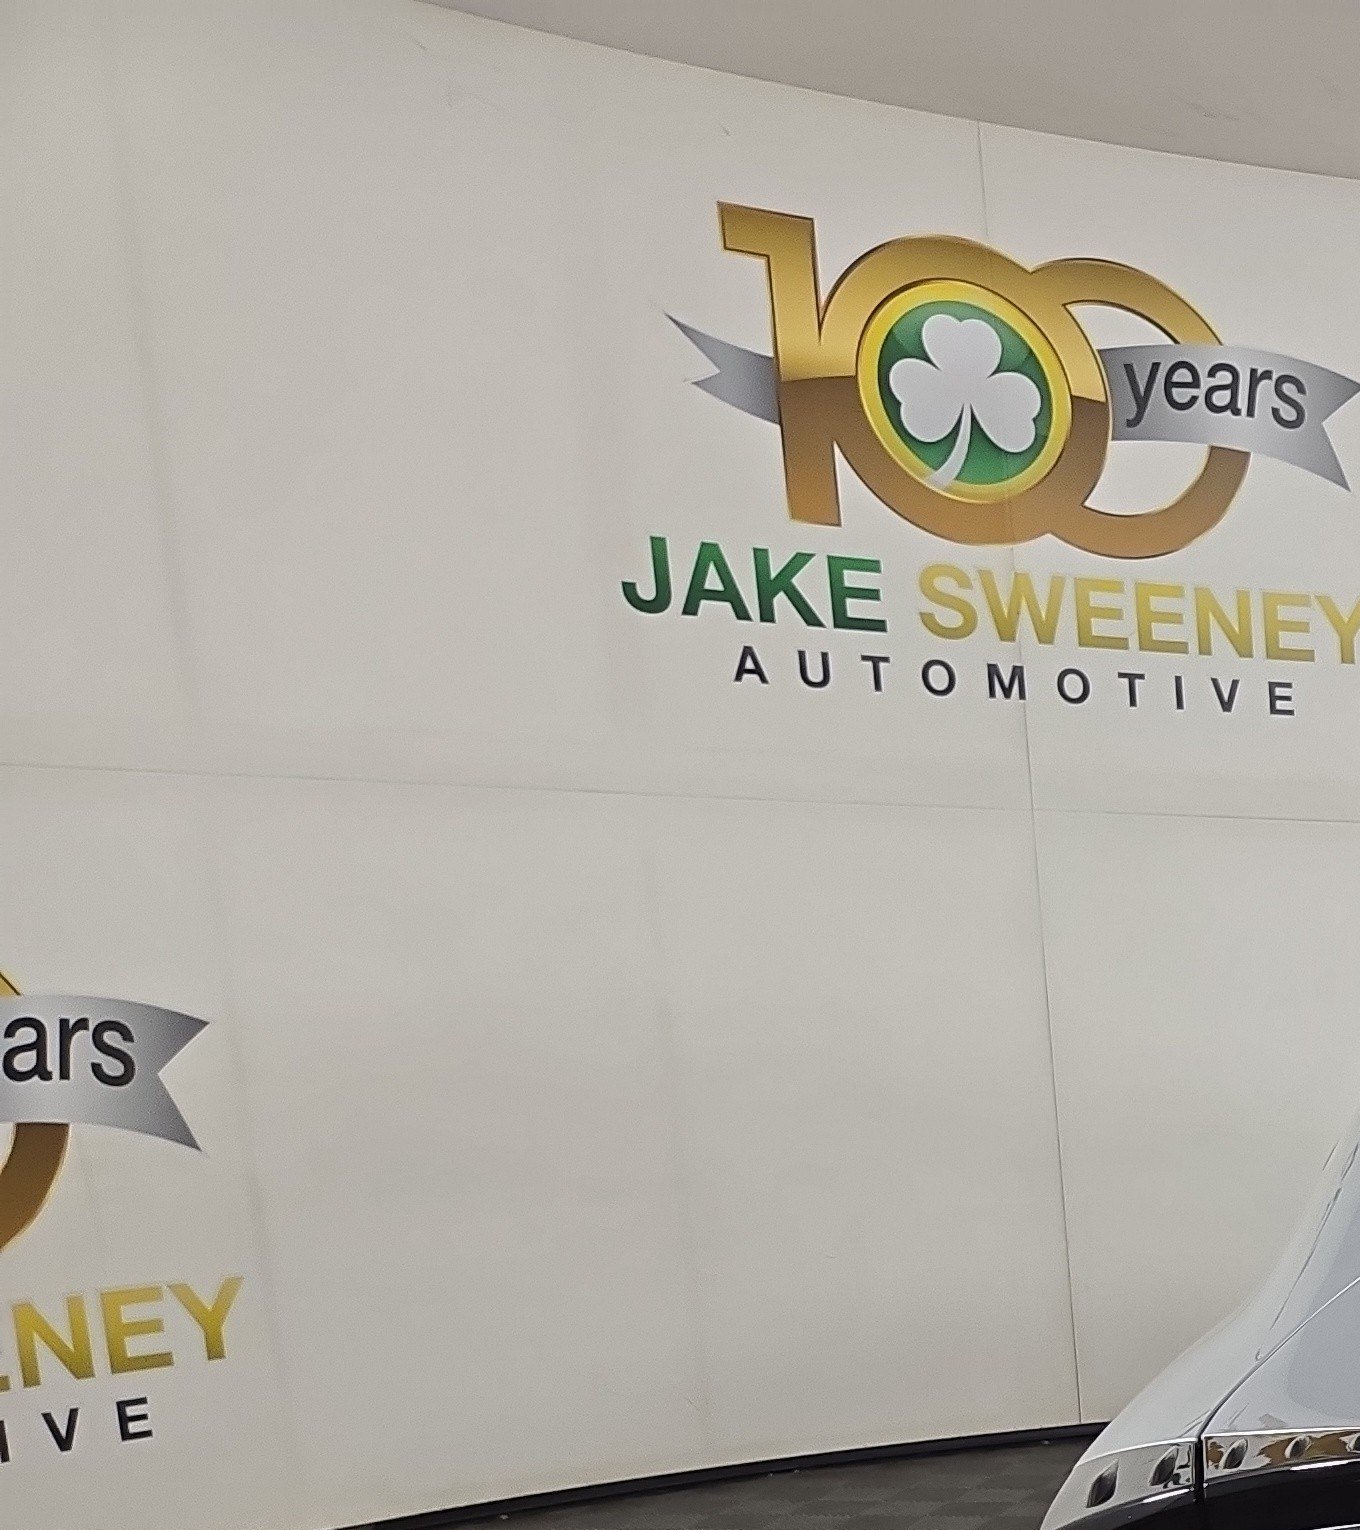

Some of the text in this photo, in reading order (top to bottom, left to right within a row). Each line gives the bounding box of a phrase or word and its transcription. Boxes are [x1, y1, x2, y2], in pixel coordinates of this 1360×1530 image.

[1122, 359, 1308, 430] years
[621, 535, 888, 633] JAKE
[734, 645, 1295, 716] AUTOMOTIVE
[0, 1275, 244, 1392] NEY
